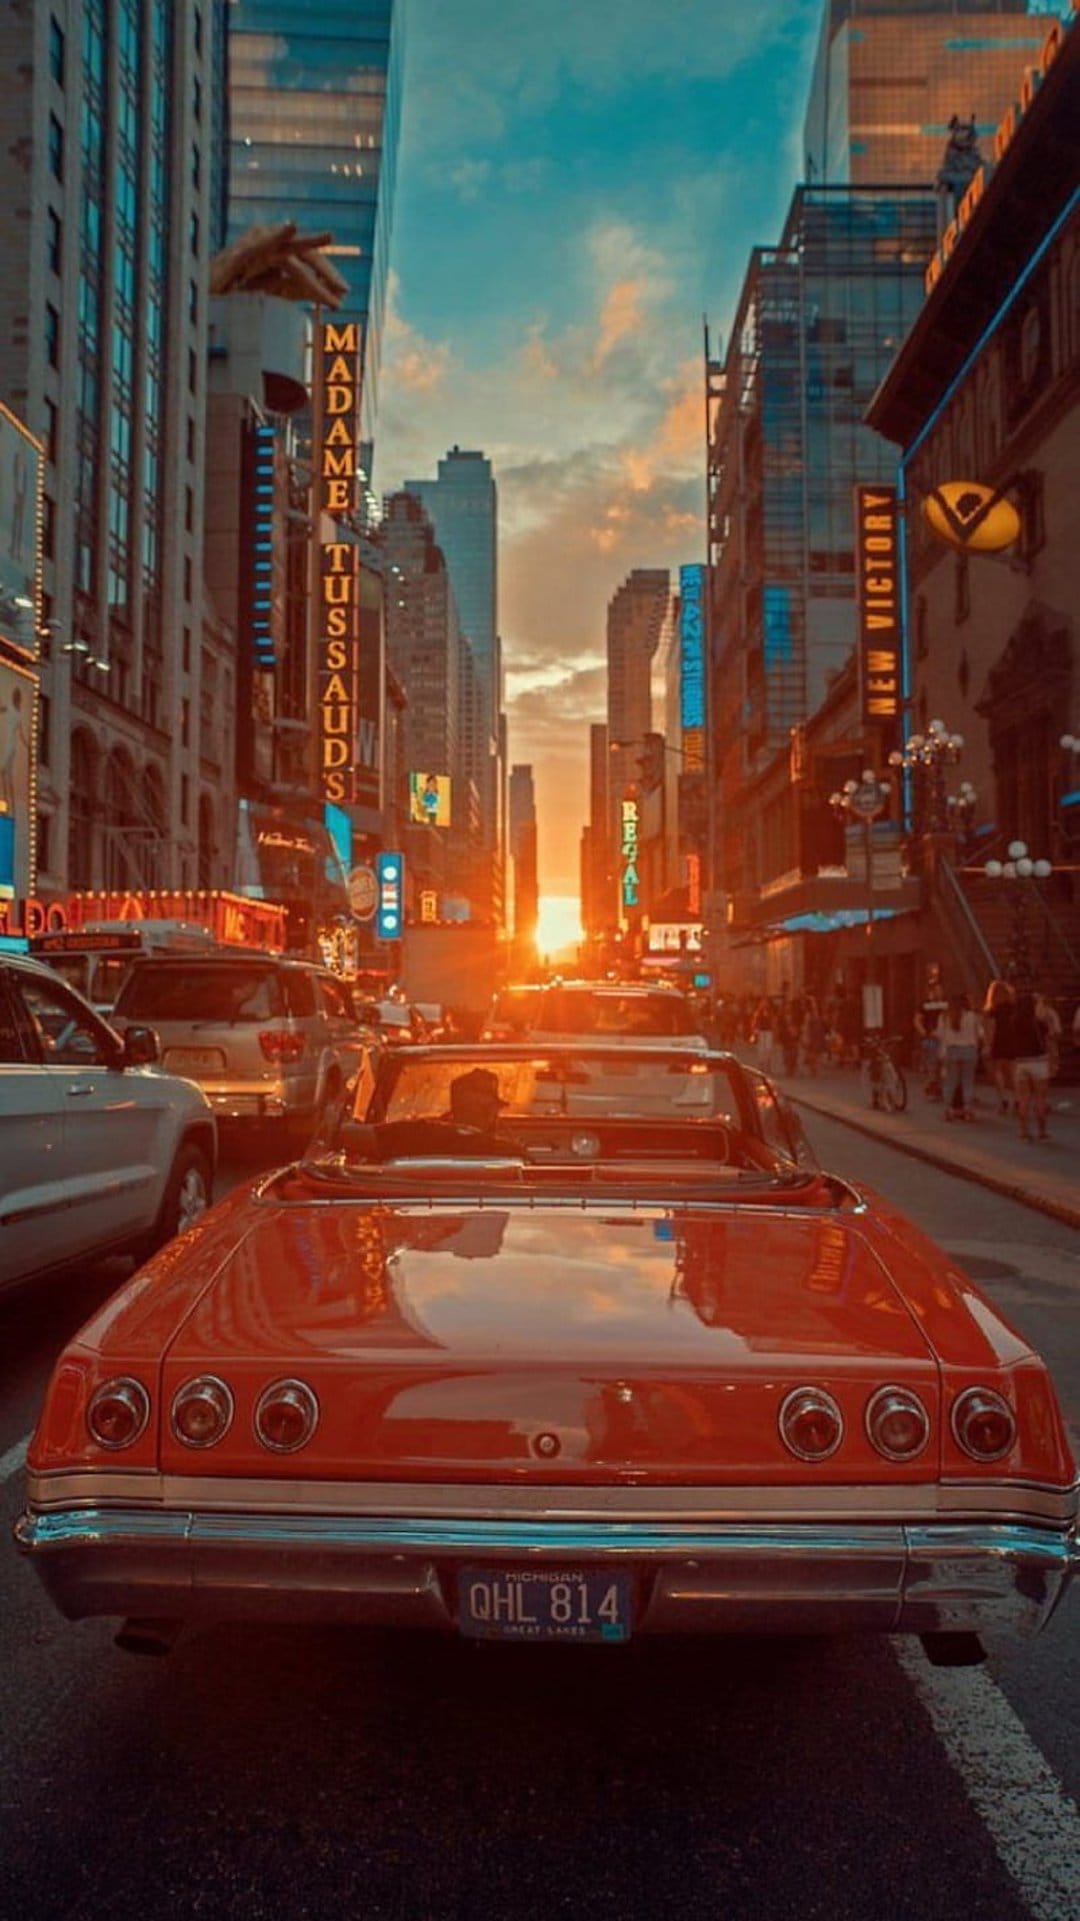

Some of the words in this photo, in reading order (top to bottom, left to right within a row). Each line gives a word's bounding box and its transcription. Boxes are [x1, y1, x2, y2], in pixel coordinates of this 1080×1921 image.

[323, 323, 356, 509] MADAME
[863, 493, 895, 630] VICTORY
[322, 543, 352, 801] TUSSAUDS
[866, 651, 897, 715] NEW
[622, 801, 639, 905] REGAL
[470, 1583, 537, 1622] QHL
[551, 1583, 619, 1624] 814
[505, 1572, 583, 1583] MICHIGAN
